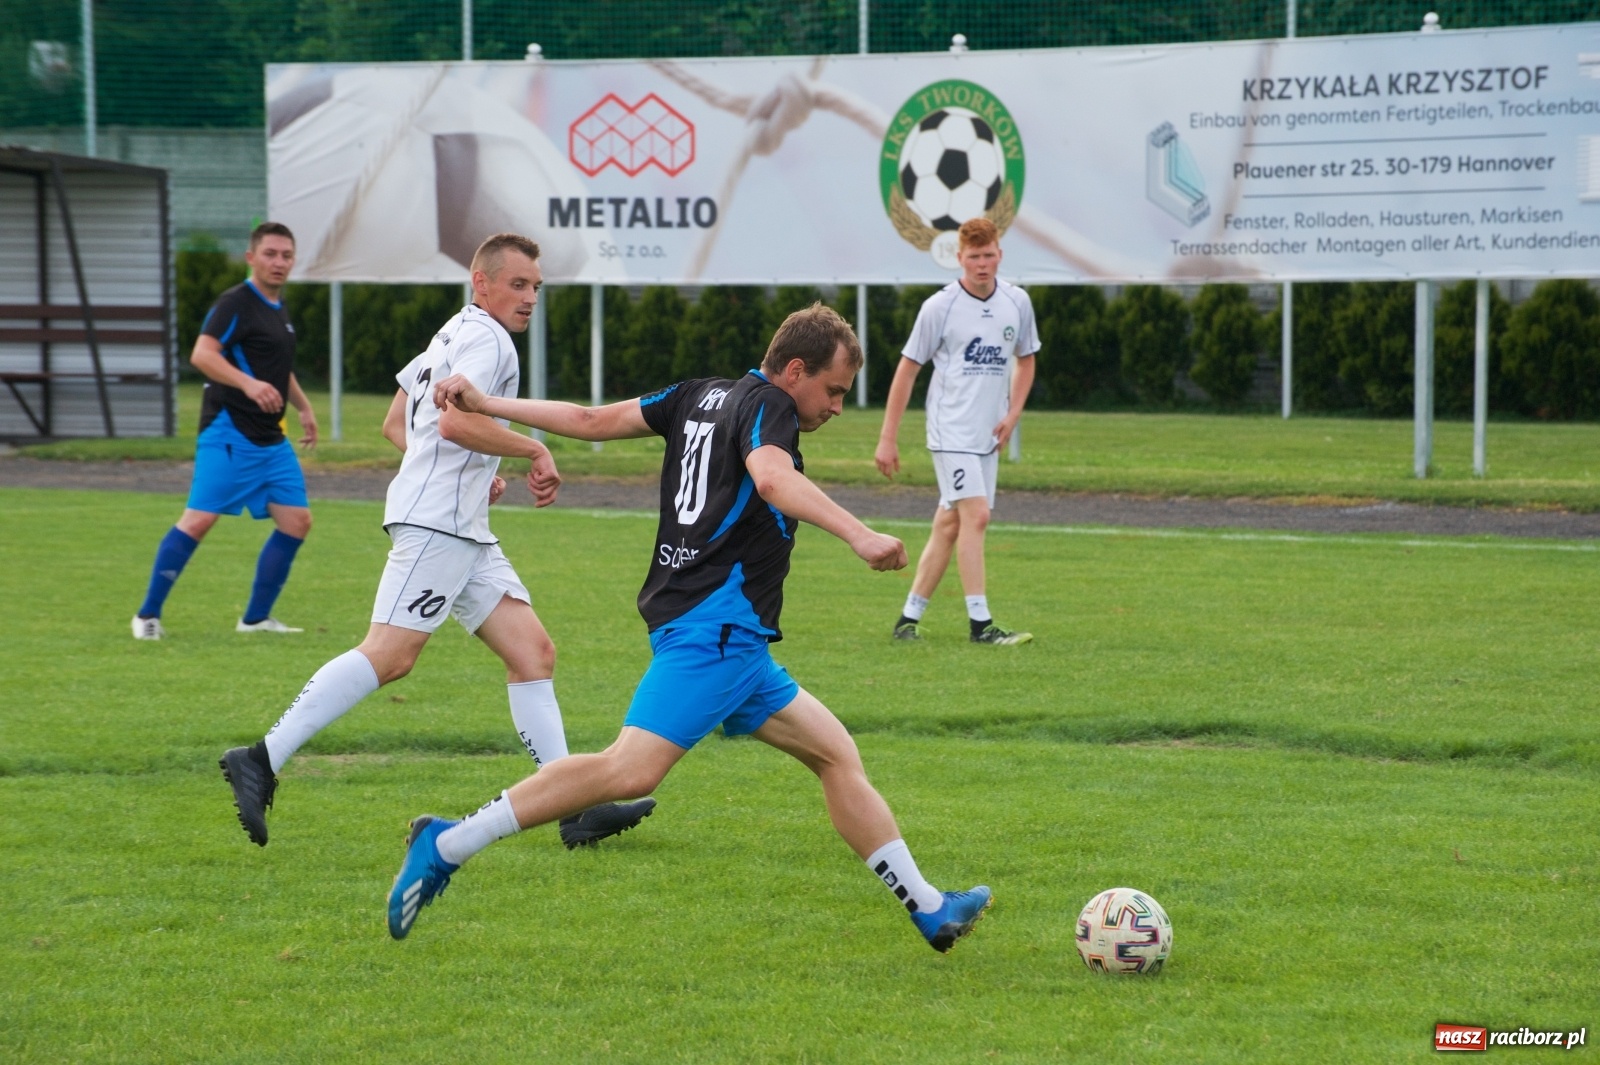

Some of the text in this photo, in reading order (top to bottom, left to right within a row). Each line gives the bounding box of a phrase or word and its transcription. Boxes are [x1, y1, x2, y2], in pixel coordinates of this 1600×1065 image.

[1242, 65, 1549, 101] KRZYKAŁA KRZYSZTOF
[1189, 111, 1247, 129] Einbau
[1250, 113, 1281, 127] von
[1286, 107, 1381, 131] genormten
[1386, 101, 1494, 126] Fertigteilen,
[883, 111, 915, 161] LKS
[1233, 154, 1555, 180] Plauener str 25. 30-179 Hannover
[548, 197, 718, 229] METALIO
[1224, 205, 1563, 230] Fenster, Rolladen, Hausturen, Markisen
[625, 245, 636, 259] z
[1170, 230, 1600, 258] Terrassendacher Montagen aller Art, Kundendien
[674, 419, 716, 525] 10
[953, 468, 965, 491] 2
[407, 588, 446, 619] 10
